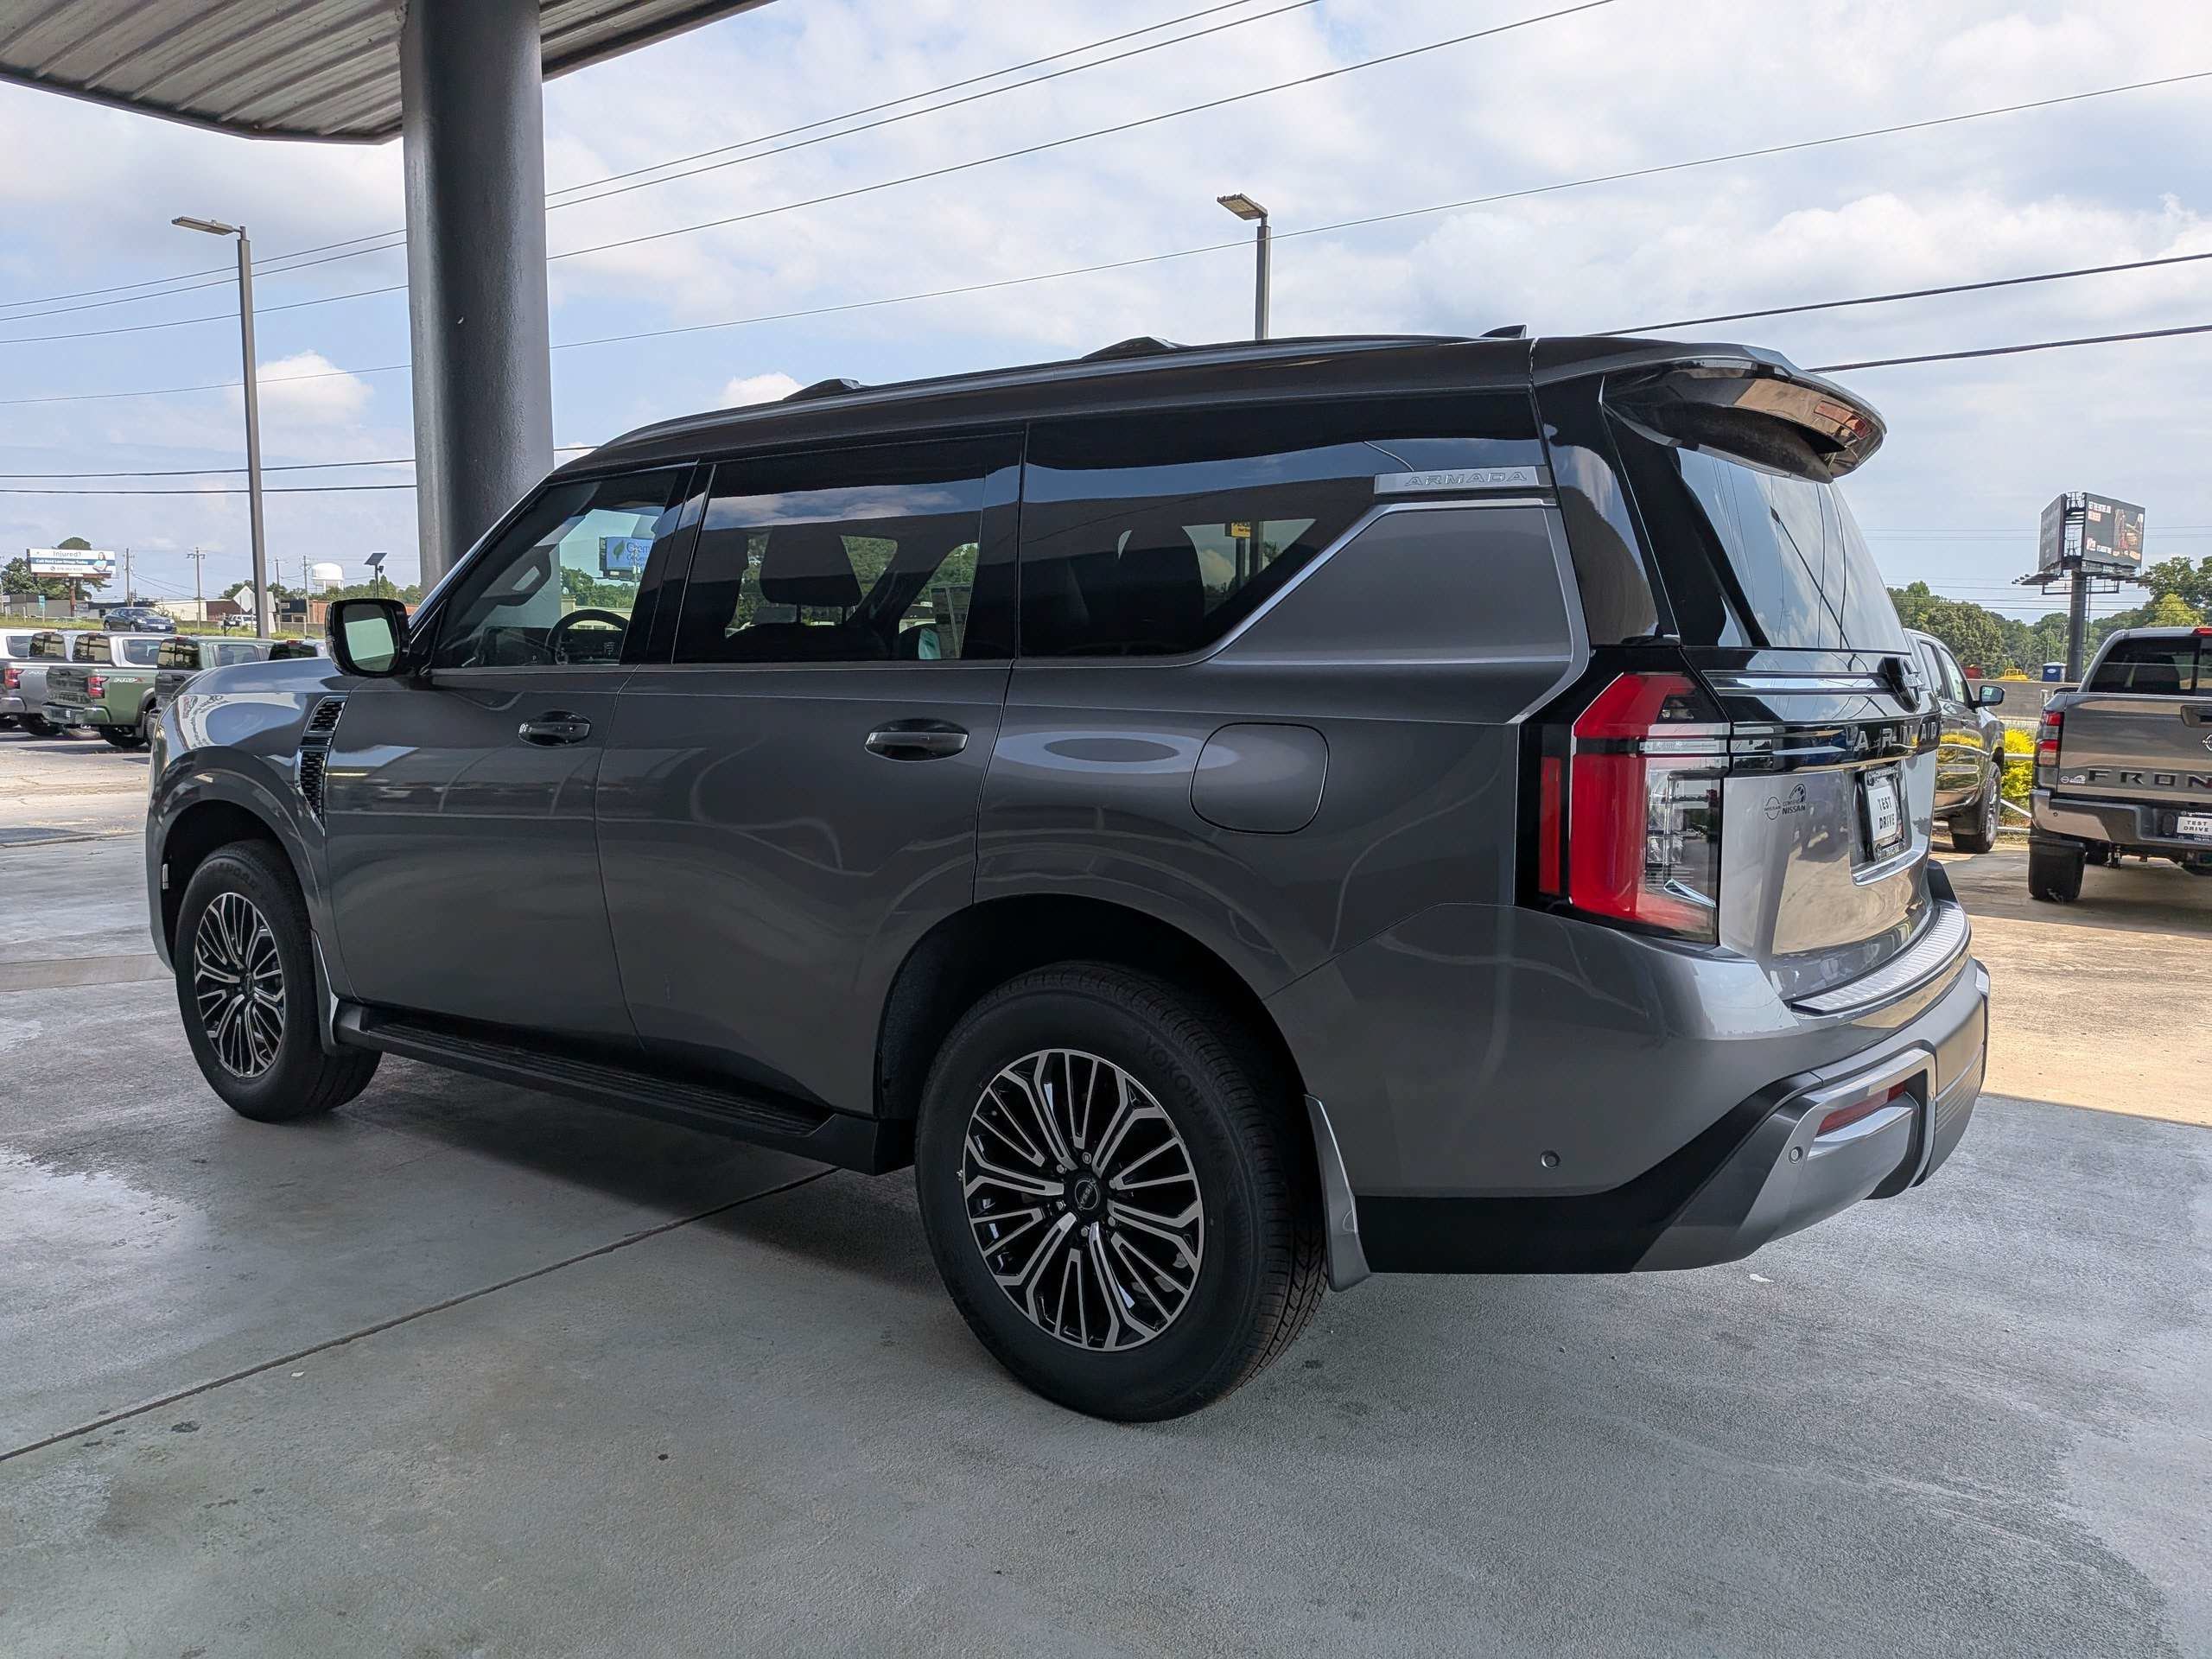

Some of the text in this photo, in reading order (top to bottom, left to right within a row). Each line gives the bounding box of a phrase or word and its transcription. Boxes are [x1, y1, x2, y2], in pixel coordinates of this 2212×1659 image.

[1405, 471, 1528, 487] ARMADA
[626, 543, 651, 553] Cem
[1782, 804, 1806, 815] NISSAN
[1877, 796, 1892, 811] TEST
[1878, 813, 1895, 830] DRIVE
